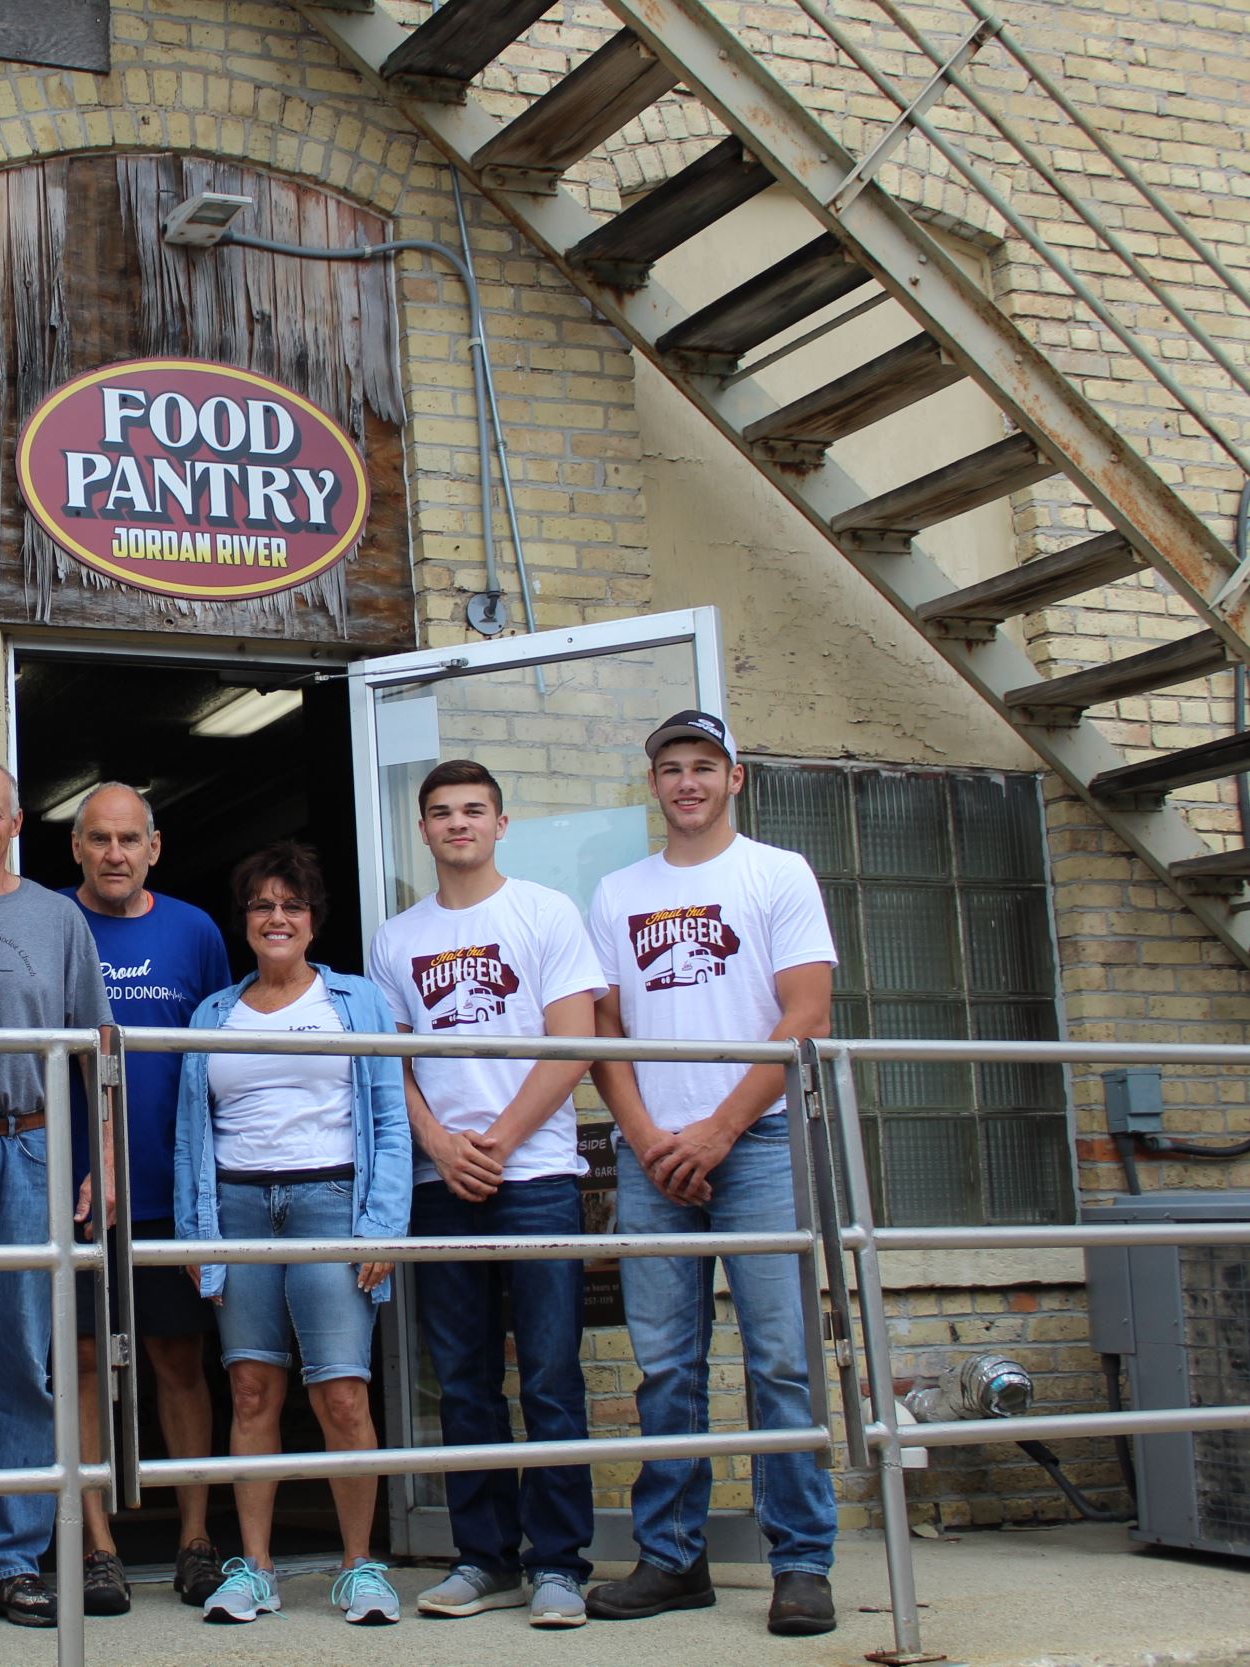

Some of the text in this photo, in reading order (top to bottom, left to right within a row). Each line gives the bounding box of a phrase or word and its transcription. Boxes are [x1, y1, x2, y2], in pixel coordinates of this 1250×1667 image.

[102, 388, 295, 456] FOOD
[65, 451, 336, 527] PANTRY
[111, 526, 288, 569] JORDAN RIVER
[645, 905, 708, 925] Haul Out
[466, 944, 488, 958] Out
[636, 918, 726, 958] HUNGER
[18, 949, 37, 977] Church
[100, 959, 151, 980] Proud
[421, 958, 506, 998] HUNGER
[125, 986, 168, 1000] DONOR
[578, 1138, 606, 1150] SIDE
